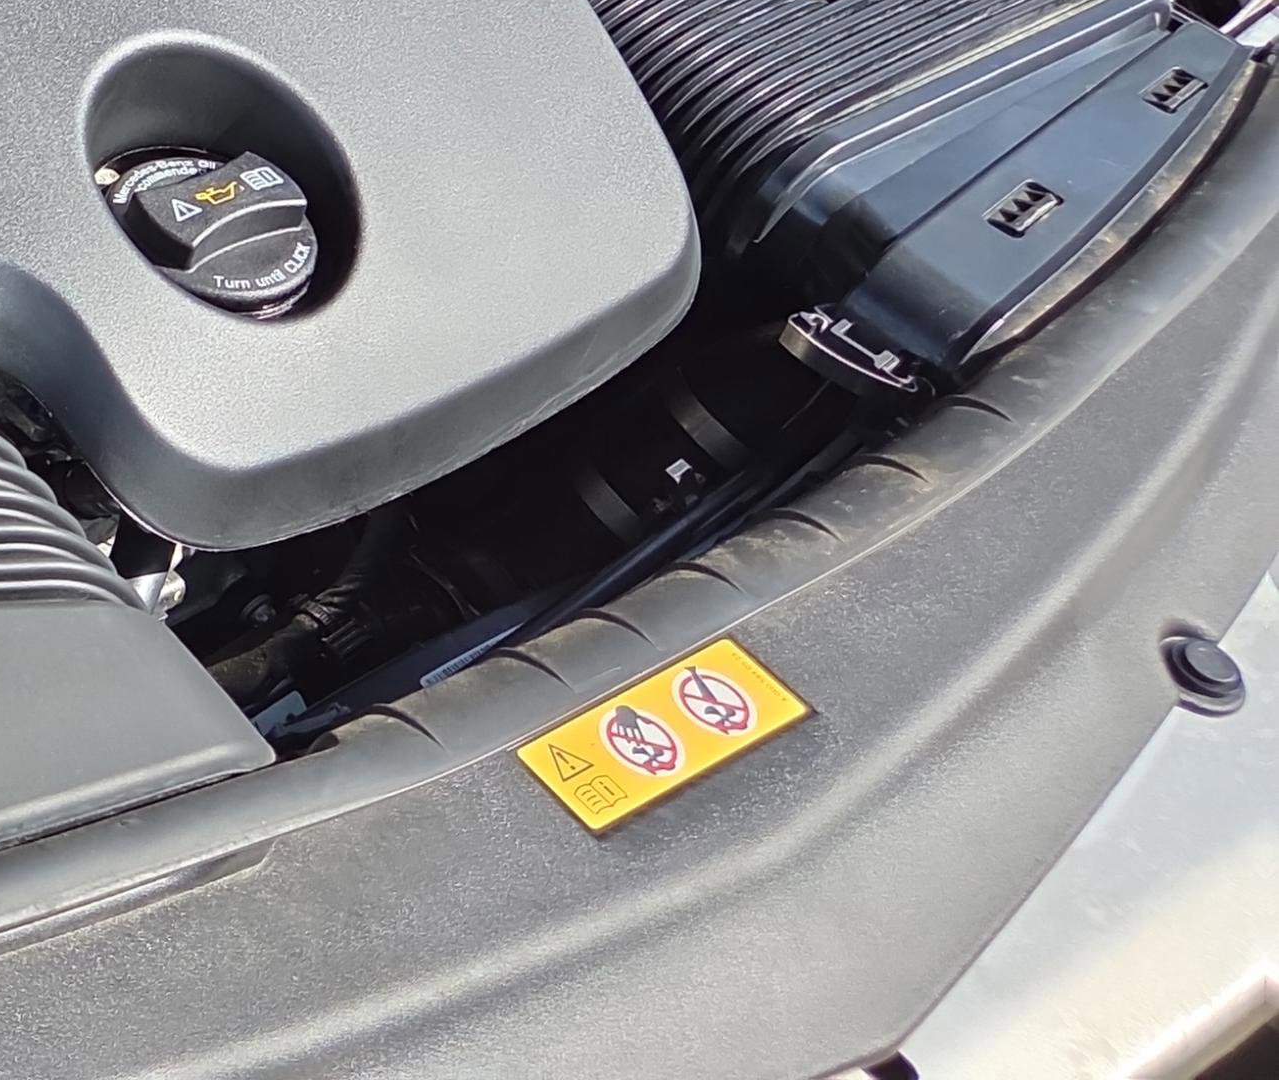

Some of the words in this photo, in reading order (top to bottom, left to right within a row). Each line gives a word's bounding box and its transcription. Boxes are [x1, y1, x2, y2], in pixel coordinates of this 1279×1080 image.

[112, 160, 195, 204] Mercedes-Benz
[198, 160, 216, 170] Oil
[212, 275, 251, 289] Turn
[254, 269, 286, 287] until
[284, 242, 311, 273] CLICK
